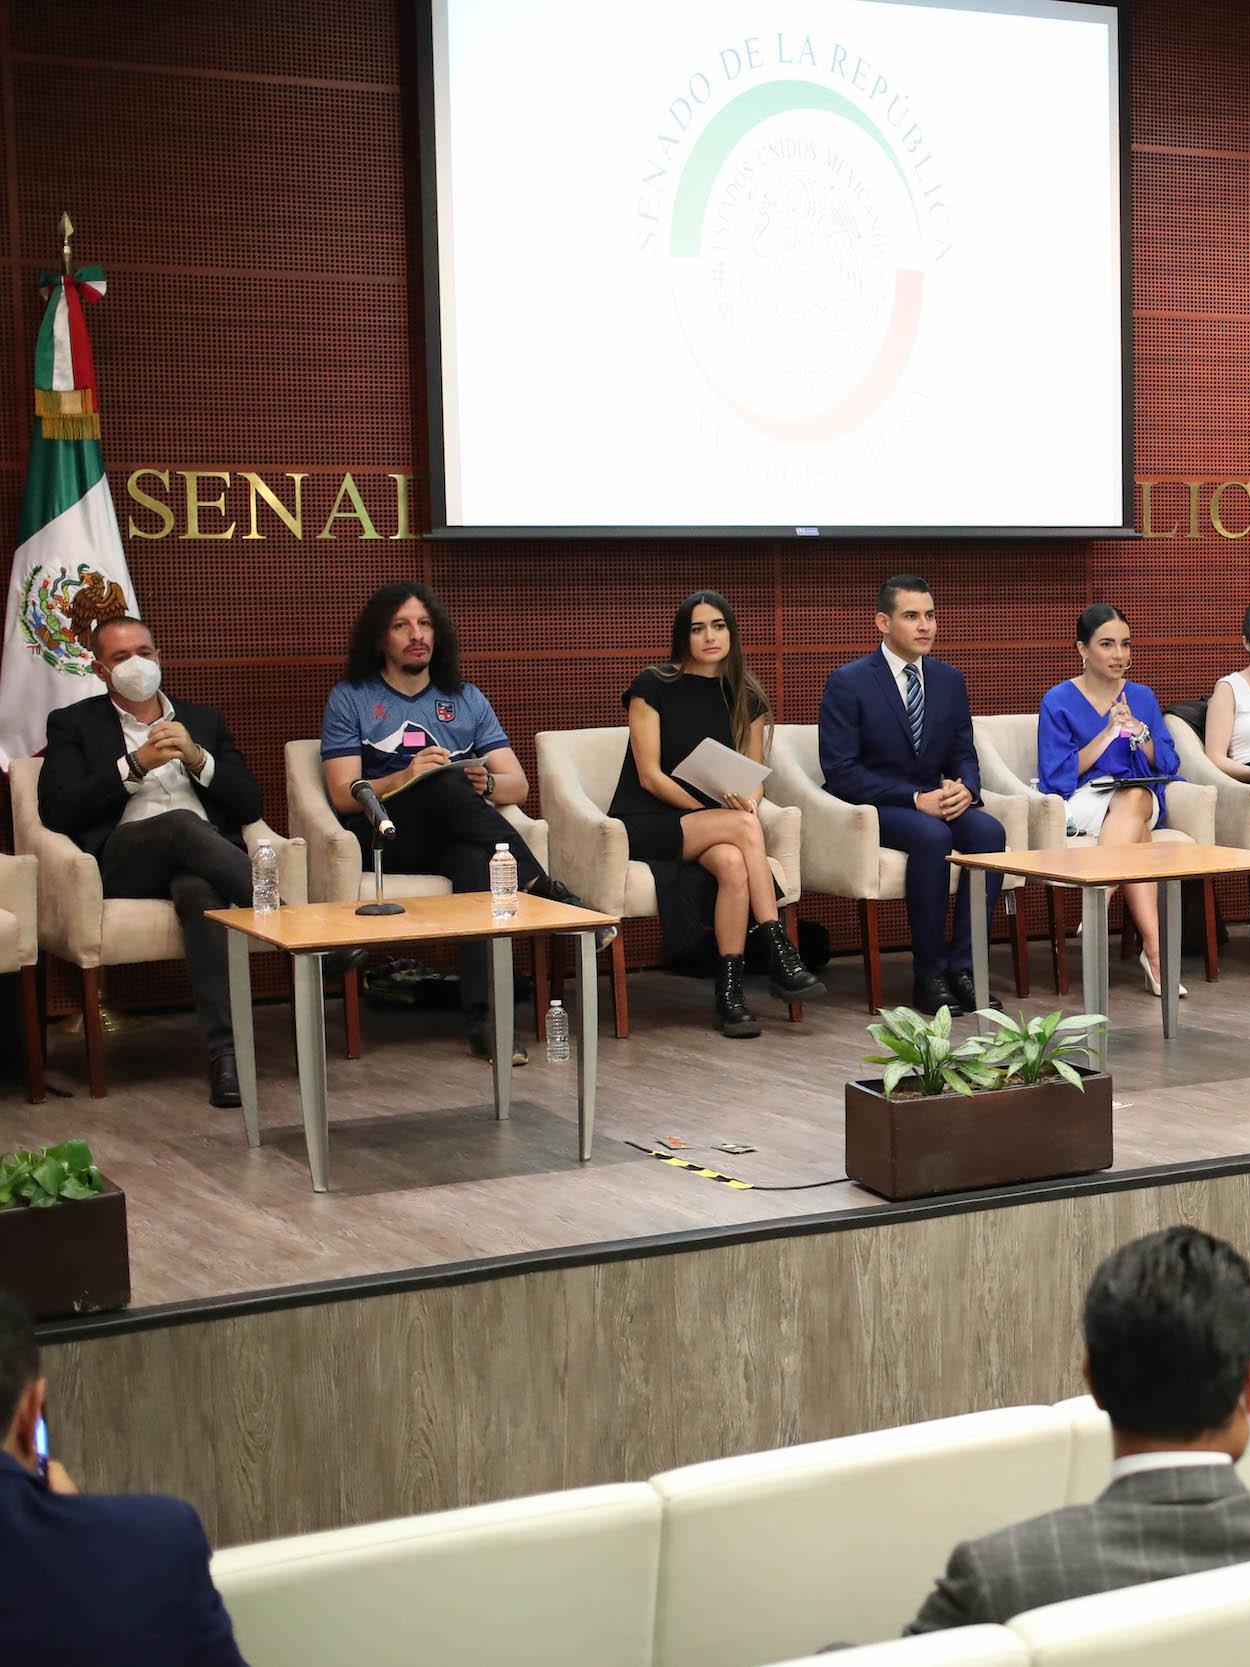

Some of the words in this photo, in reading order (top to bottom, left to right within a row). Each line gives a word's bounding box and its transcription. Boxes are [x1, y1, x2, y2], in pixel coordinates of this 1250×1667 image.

[632, 71, 712, 254] SENADO
[719, 36, 765, 81] DE
[775, 32, 817, 66] LA
[830, 43, 954, 262] REPÚBLICA
